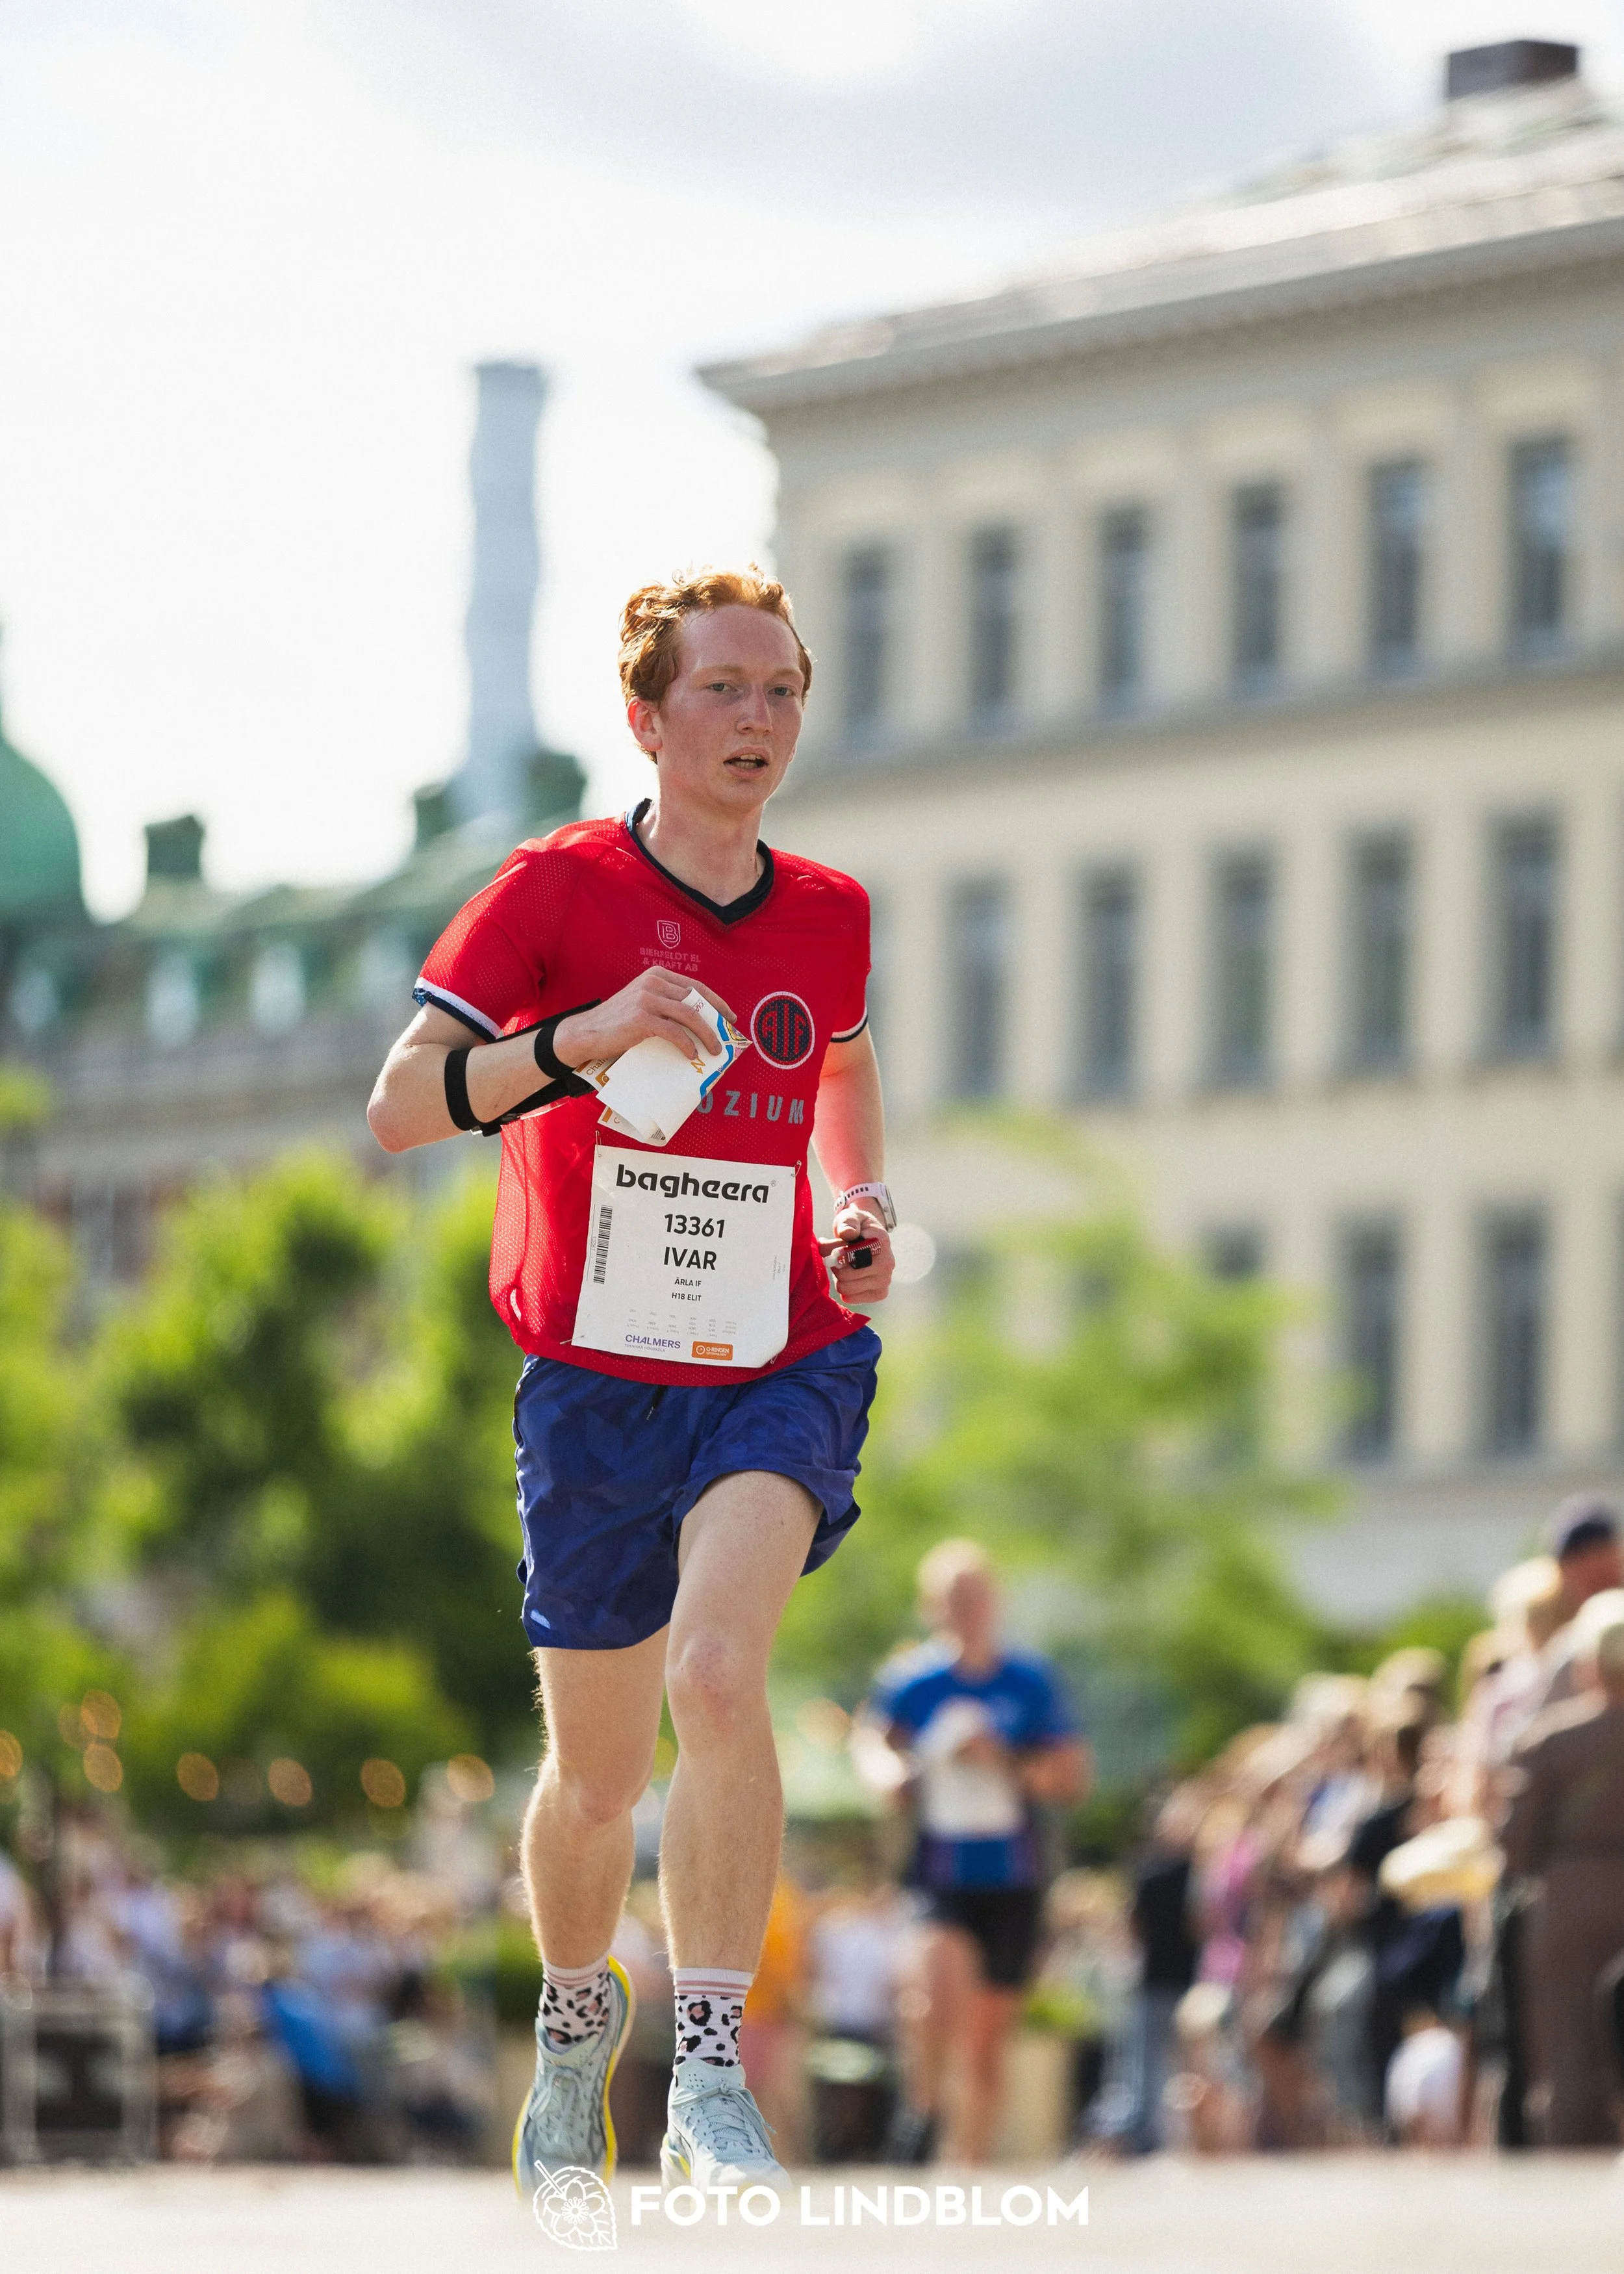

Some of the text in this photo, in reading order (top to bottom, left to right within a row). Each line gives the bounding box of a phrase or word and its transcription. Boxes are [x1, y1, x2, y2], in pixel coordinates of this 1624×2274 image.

[642, 957, 698, 972] & KRAFT AB
[691, 954, 702, 962] EL
[696, 1090, 805, 1125] OZIUM
[616, 1164, 769, 1203] bagheera
[664, 1214, 725, 1238] 13361
[663, 1247, 717, 1271] IVAR
[674, 1277, 694, 1286] ÄRLA
[625, 1334, 681, 1349] CHALMERS
